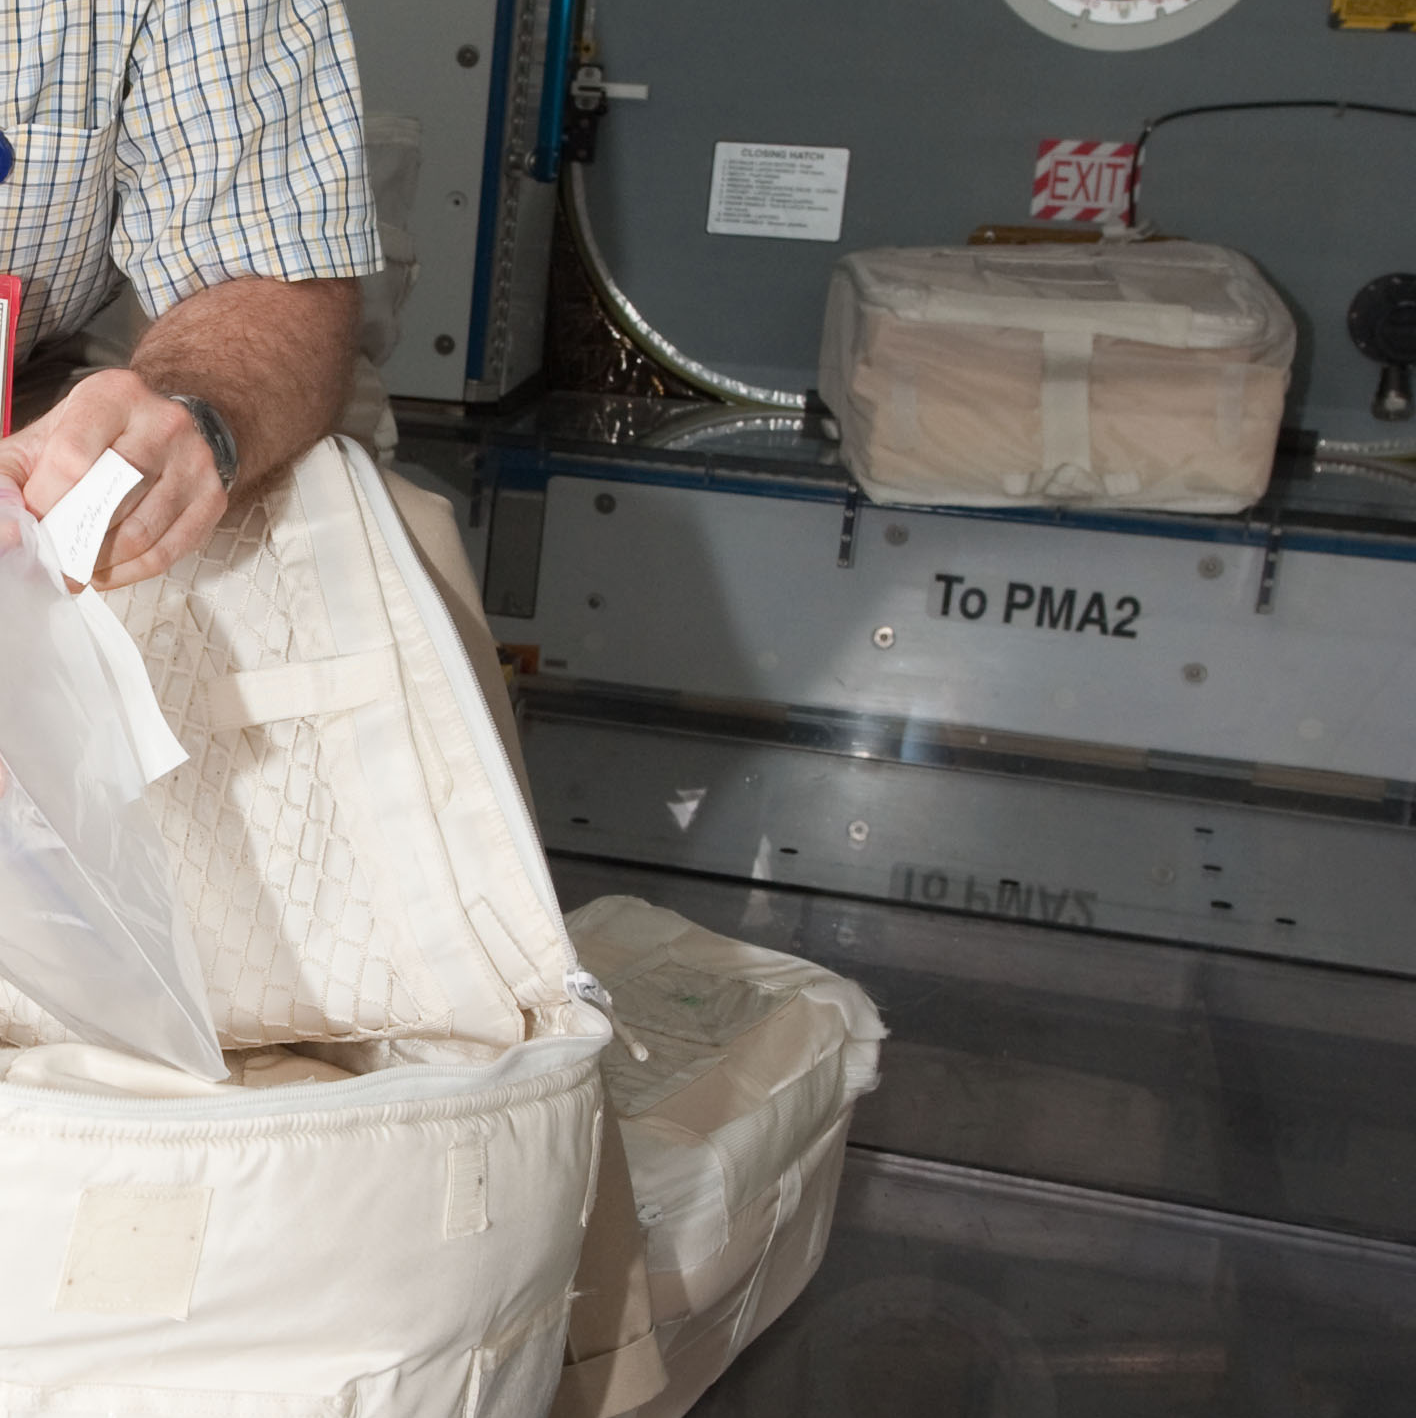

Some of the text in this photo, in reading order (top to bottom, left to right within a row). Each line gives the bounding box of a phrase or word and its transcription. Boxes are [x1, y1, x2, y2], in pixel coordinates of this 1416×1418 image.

[740, 147, 825, 160] CLOSING HATCH
[1050, 160, 1125, 203] EXIT
[935, 573, 1142, 639] To PMA2
